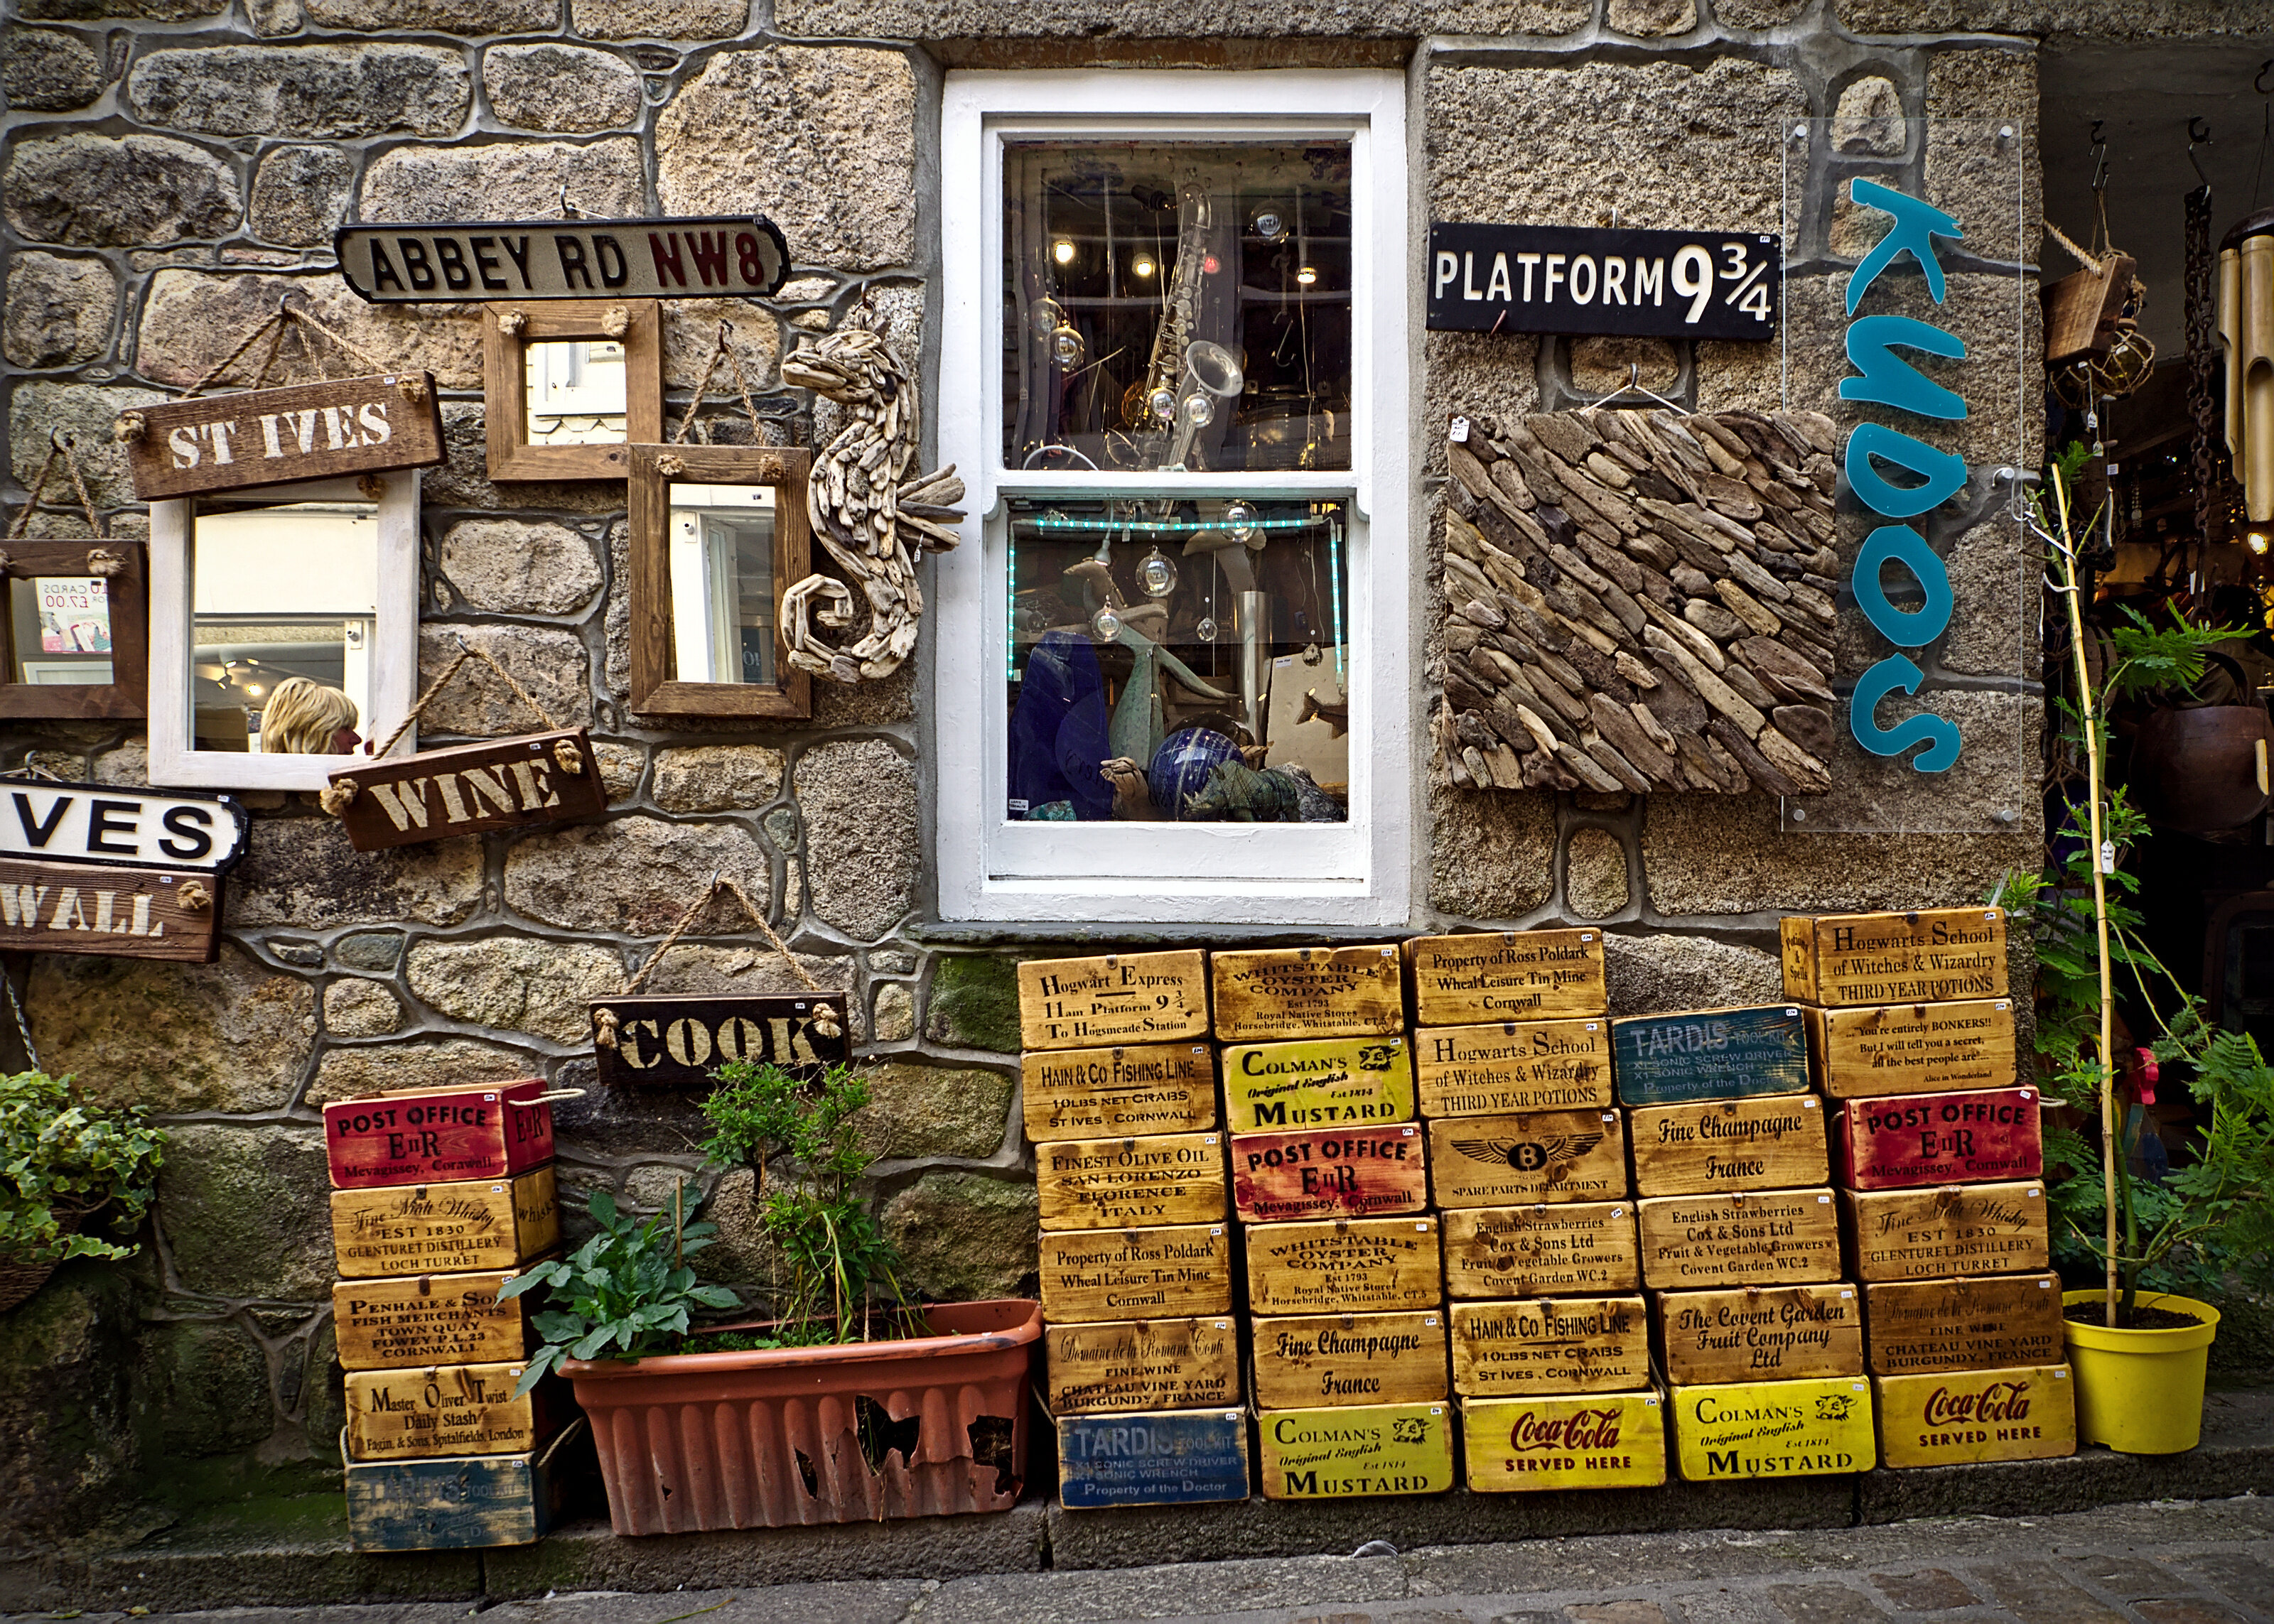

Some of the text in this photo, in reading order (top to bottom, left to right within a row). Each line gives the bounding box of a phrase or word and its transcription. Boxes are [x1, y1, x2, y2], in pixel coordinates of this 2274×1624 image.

[369, 232, 765, 291] ABBEY RD NW8
[1435, 250, 1664, 306] PLATFORM
[168, 403, 391, 470] ST IVES
[1840, 176, 1968, 773] KUDOS
[369, 759, 559, 831] WINE
[11, 793, 214, 860] VES
[0, 884, 163, 936] WALL
[1786, 934, 1809, 952] Potions
[1833, 921, 1993, 953] Hogwarts School
[1433, 945, 1589, 971] Property of Ross Poldark
[1834, 952, 1996, 976] of Witches & Wizardry
[1040, 965, 1183, 997] Hogwart Express
[1437, 970, 1585, 990] Wheal Leisure Tin Mine
[1790, 967, 1808, 981] Spells
[1838, 978, 1993, 1000] THIRD YEAR POTIONS
[1092, 1003, 1151, 1015] Platform
[1483, 993, 1541, 1009] Cornwall
[1046, 1017, 1187, 1039] To Hogsmeade Station
[1892, 1024, 1929, 1034] entirely
[620, 1017, 821, 1068] COOK
[1860, 1044, 1877, 1052] But
[1879, 1042, 1884, 1051] I
[1887, 1040, 1904, 1051] will
[1907, 1039, 1922, 1049] tell
[1925, 1039, 1943, 1051] you
[1954, 1036, 1984, 1045] secret,
[1872, 1059, 1883, 1068] all
[1887, 1058, 1902, 1066] the
[1904, 1056, 1924, 1066] best
[1927, 1054, 1959, 1068] people
[1042, 1059, 1195, 1087] HAIN & CO FISHING LINE
[1951, 1071, 1992, 1080] Wonderland
[1101, 1096, 1128, 1105] NET
[1133, 1092, 1188, 1103] CRABS
[338, 1107, 487, 1137] POST OFFICE
[1049, 1117, 1067, 1127] ST
[1114, 1111, 1195, 1122] CORNWALL
[1659, 1115, 1802, 1143] Fine Champagne
[1052, 1148, 1209, 1170] FINEST OLIVE OIL
[1706, 1156, 1764, 1179] France
[1062, 1169, 1201, 1186] SAN LORENZO
[1079, 1187, 1185, 1201] FLORENCE
[1453, 1180, 1607, 1196] SPARE PARTS DEPARTMENT
[439, 1197, 495, 1230] Whisky
[1102, 1206, 1165, 1217] ITALY
[381, 1225, 464, 1240] EST 1830
[348, 1237, 502, 1258] GLENTURET DISTILLERY
[1270, 1236, 1417, 1257] WHITSTABLE
[1300, 1247, 1388, 1260] OYSTER
[381, 1255, 479, 1271] LOCH TURRET
[1287, 1255, 1396, 1270] COMPANY
[1345, 1273, 1367, 1282] 1793
[1294, 1283, 1396, 1296] Royal Native Stores
[350, 1299, 439, 1315] PENHALE
[445, 1299, 456, 1308] &
[352, 1307, 506, 1326] FISH MERCHANTS
[1678, 1301, 1845, 1330] The Covent Garden
[377, 1321, 480, 1337] TOWN QUAY
[1696, 1327, 1830, 1350] Fruit Company
[372, 1336, 433, 1349] FOWEY
[382, 1344, 475, 1358] CORNWALL
[1885, 1336, 2052, 1355] CHATEAU VINE YARD
[1750, 1348, 1782, 1368] Ltd
[371, 1379, 507, 1413] Master Oliver Twist
[1696, 1398, 1803, 1424] COLMAN'S
[405, 1412, 478, 1431] Daily Stash
[397, 1437, 405, 1449] &
[488, 1428, 524, 1441] London
[1074, 1427, 1173, 1456] TARDIS
[1700, 1421, 1804, 1446] Original English
[1919, 1427, 2041, 1446] SERVED HERE
[1786, 1440, 1802, 1449] Est
[1506, 1456, 1631, 1471] SERVED HERE
[1706, 1451, 1853, 1476] MUSTARD
[1084, 1480, 1227, 1496] Property of the Doctor
